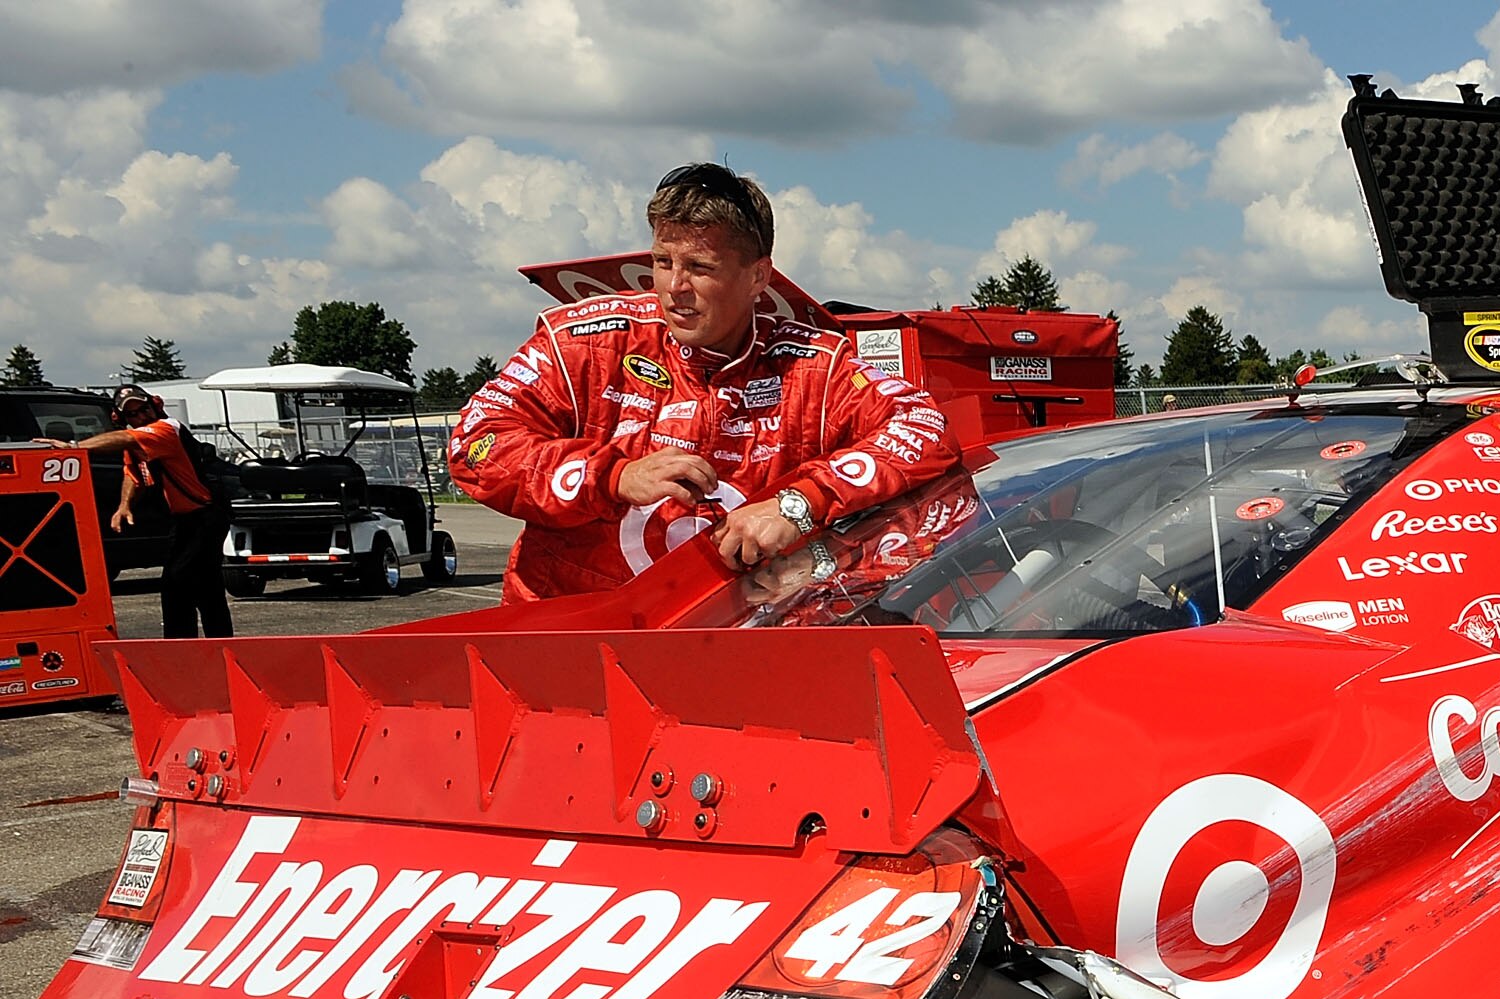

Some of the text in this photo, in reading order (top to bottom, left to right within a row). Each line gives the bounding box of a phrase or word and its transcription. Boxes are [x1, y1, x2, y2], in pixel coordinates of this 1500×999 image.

[567, 300, 657, 318] GOODYEAR
[1477, 313, 1500, 321] SPRINT
[572, 320, 626, 335] IMPACT
[1005, 357, 1047, 368] GANASSI
[601, 385, 656, 411] Energizer
[43, 458, 80, 482] 20
[1371, 510, 1498, 541] Reese's
[1337, 552, 1467, 581] Lexar
[1357, 598, 1405, 614] MEN
[1286, 611, 1349, 623] Vaseline
[1362, 613, 1410, 626] LOTION
[115, 887, 145, 898] RACING
[783, 885, 962, 988] 42
